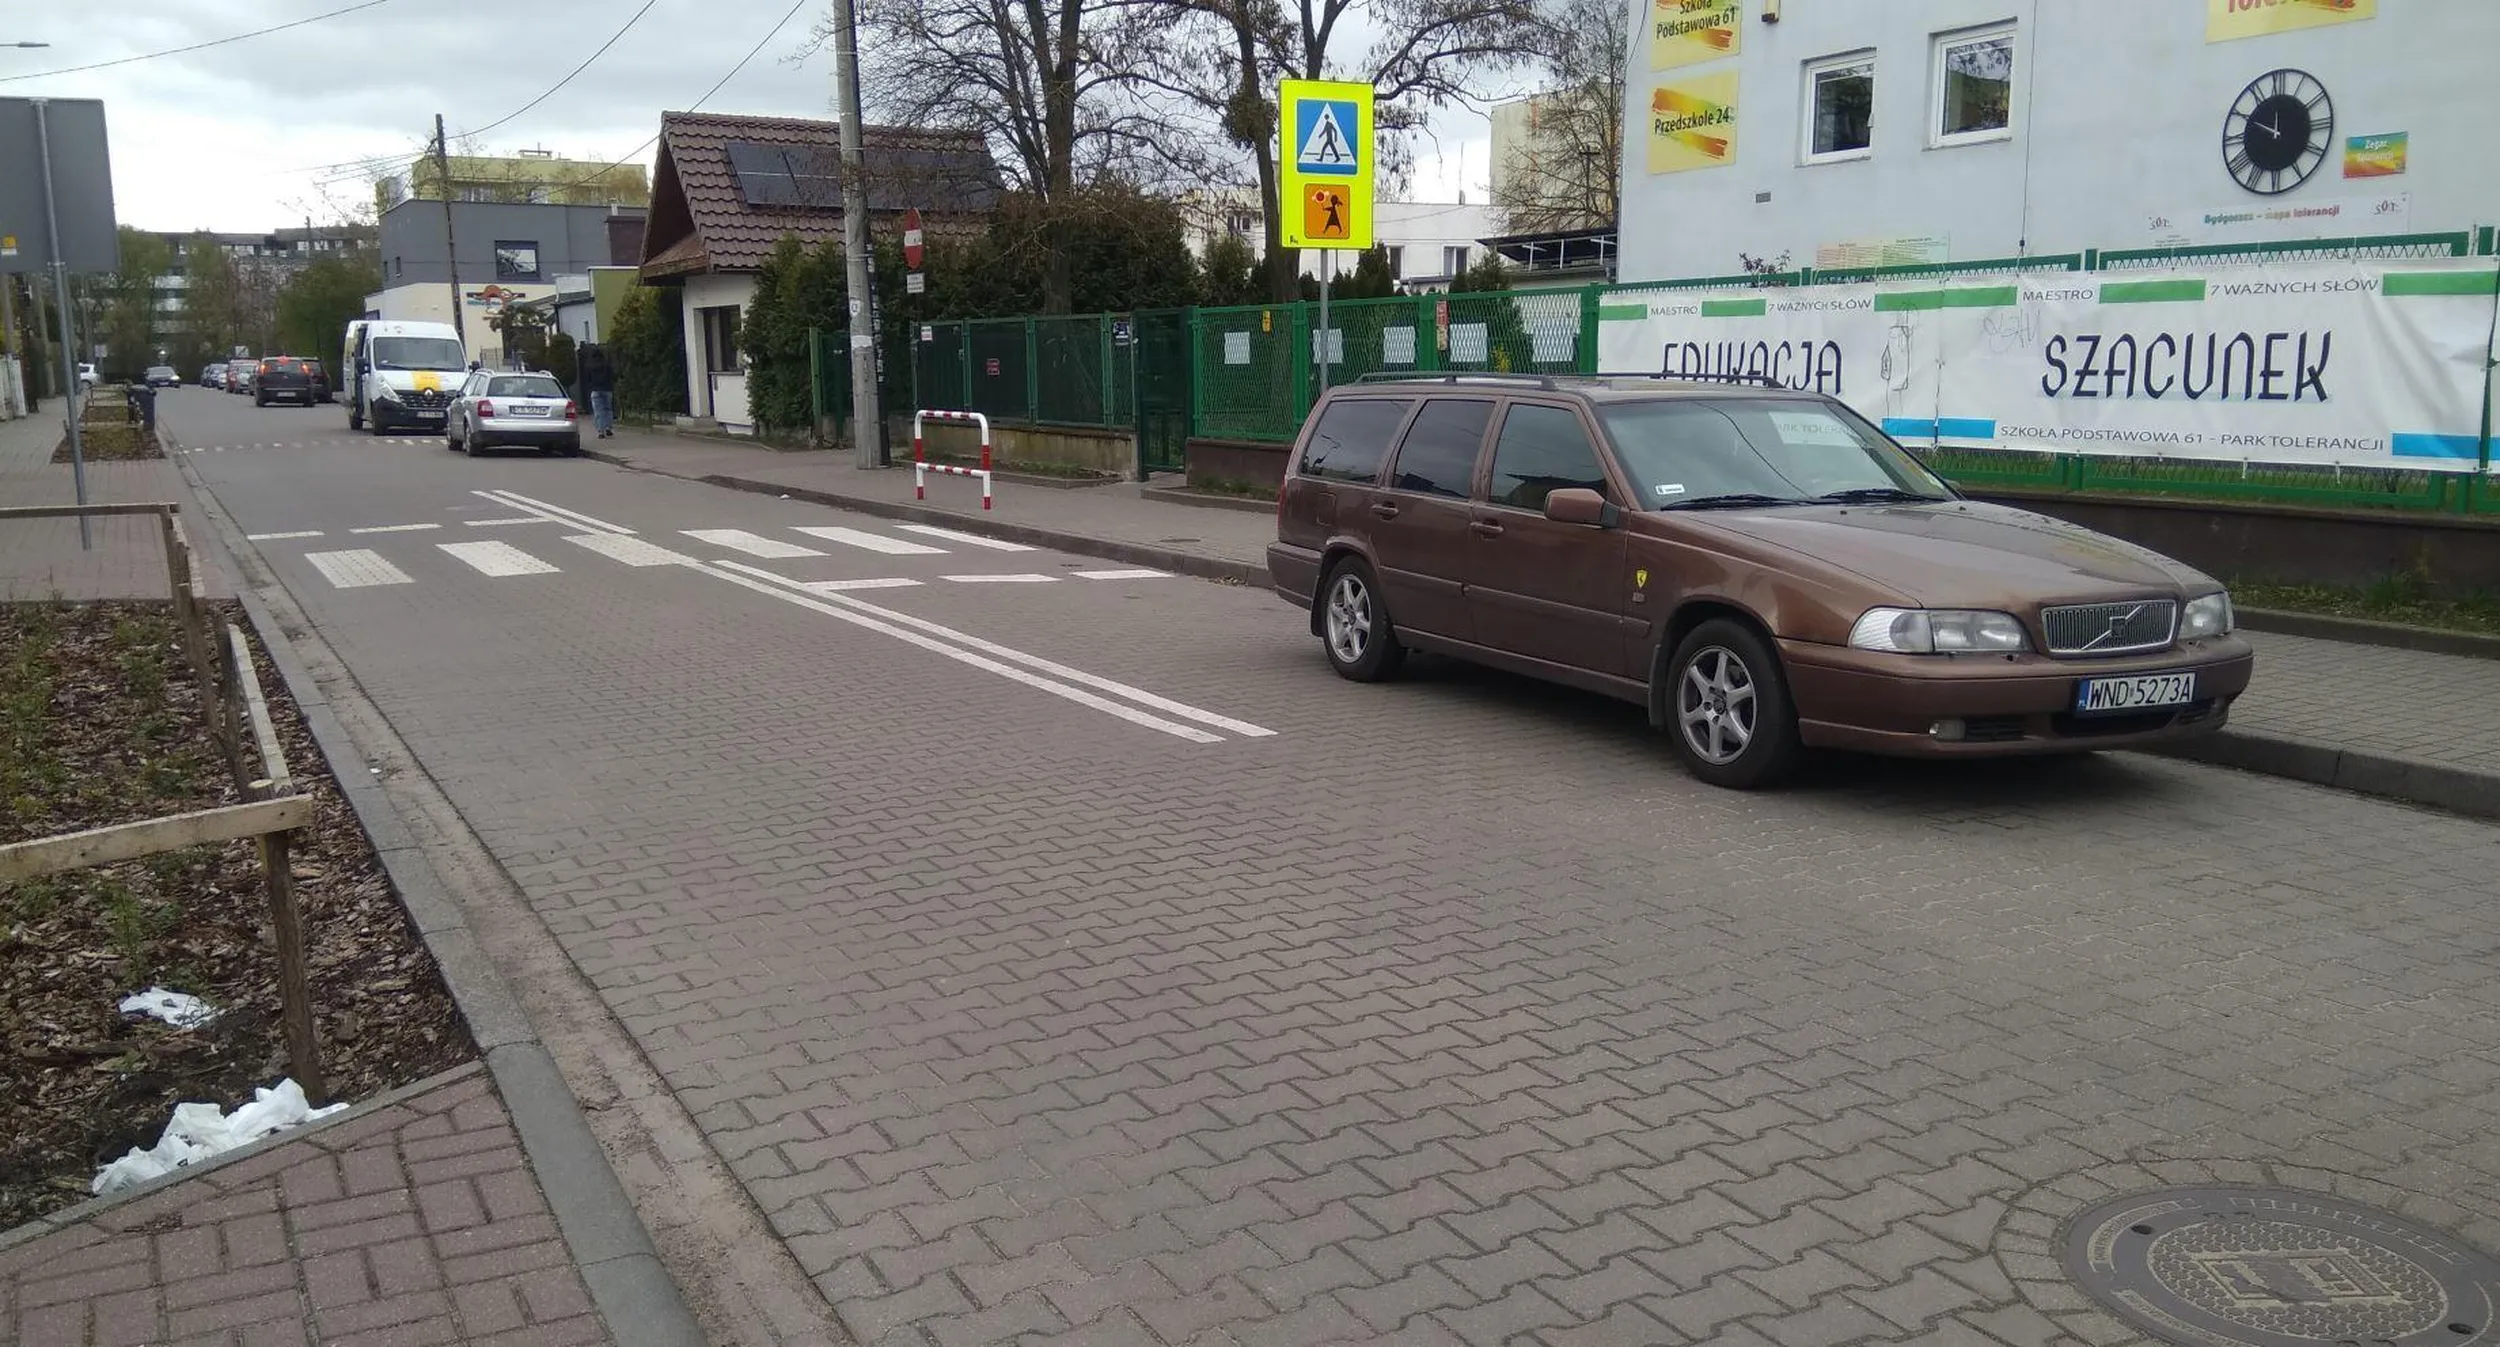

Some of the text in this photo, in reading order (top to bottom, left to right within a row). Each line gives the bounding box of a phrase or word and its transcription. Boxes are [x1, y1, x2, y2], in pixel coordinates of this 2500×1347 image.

[1656, 6, 1736, 39] Podstawowa 61
[1654, 105, 1730, 134] Przedszkole 24
[2293, 204, 2341, 218] tolerancji
[2022, 288, 2093, 301] MAESTRO
[2210, 278, 2379, 295] 7 WAŻNYCH SŁÓW
[1650, 305, 1698, 316] MAESTRO
[1768, 303, 1775, 312] 7
[1830, 299, 1872, 310] SŁÓW
[1662, 340, 1843, 395] EDUKACJA
[2041, 330, 2332, 402] SZACUNEK
[2000, 426, 2057, 439] SZKOŁA
[2061, 428, 2179, 444] PODSTAWOWA
[2184, 433, 2203, 444] 61
[2220, 434, 2266, 446] PARK
[2270, 435, 2384, 451] TOLERANCJI
[2089, 675, 2190, 709] WND 5273A
